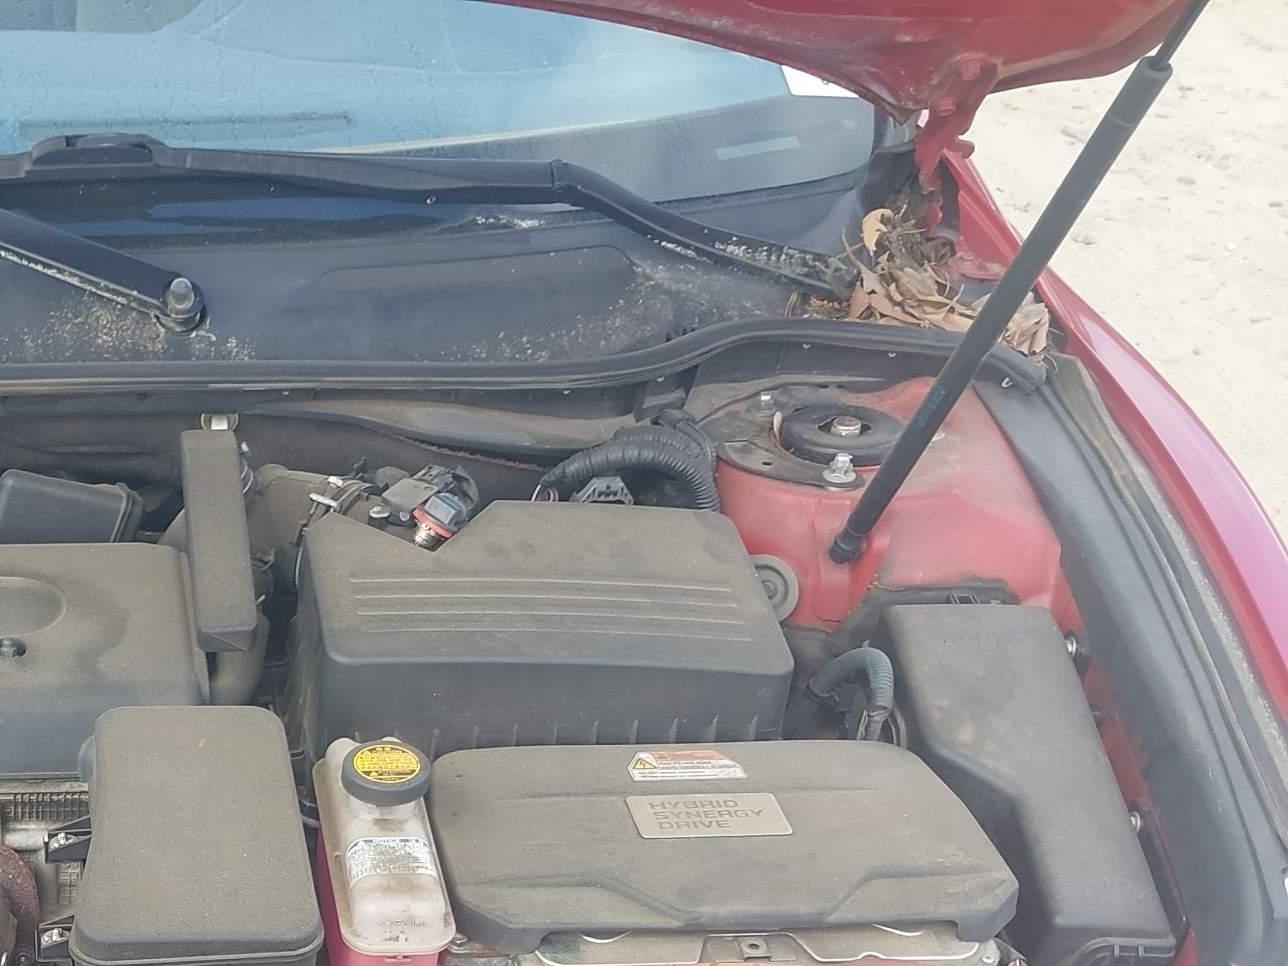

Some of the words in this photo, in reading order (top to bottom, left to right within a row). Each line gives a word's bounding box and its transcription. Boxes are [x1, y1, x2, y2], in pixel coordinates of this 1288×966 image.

[648, 799, 739, 810] HYBRID
[652, 808, 763, 820] SYNERGY
[657, 820, 732, 830] DRIVE
